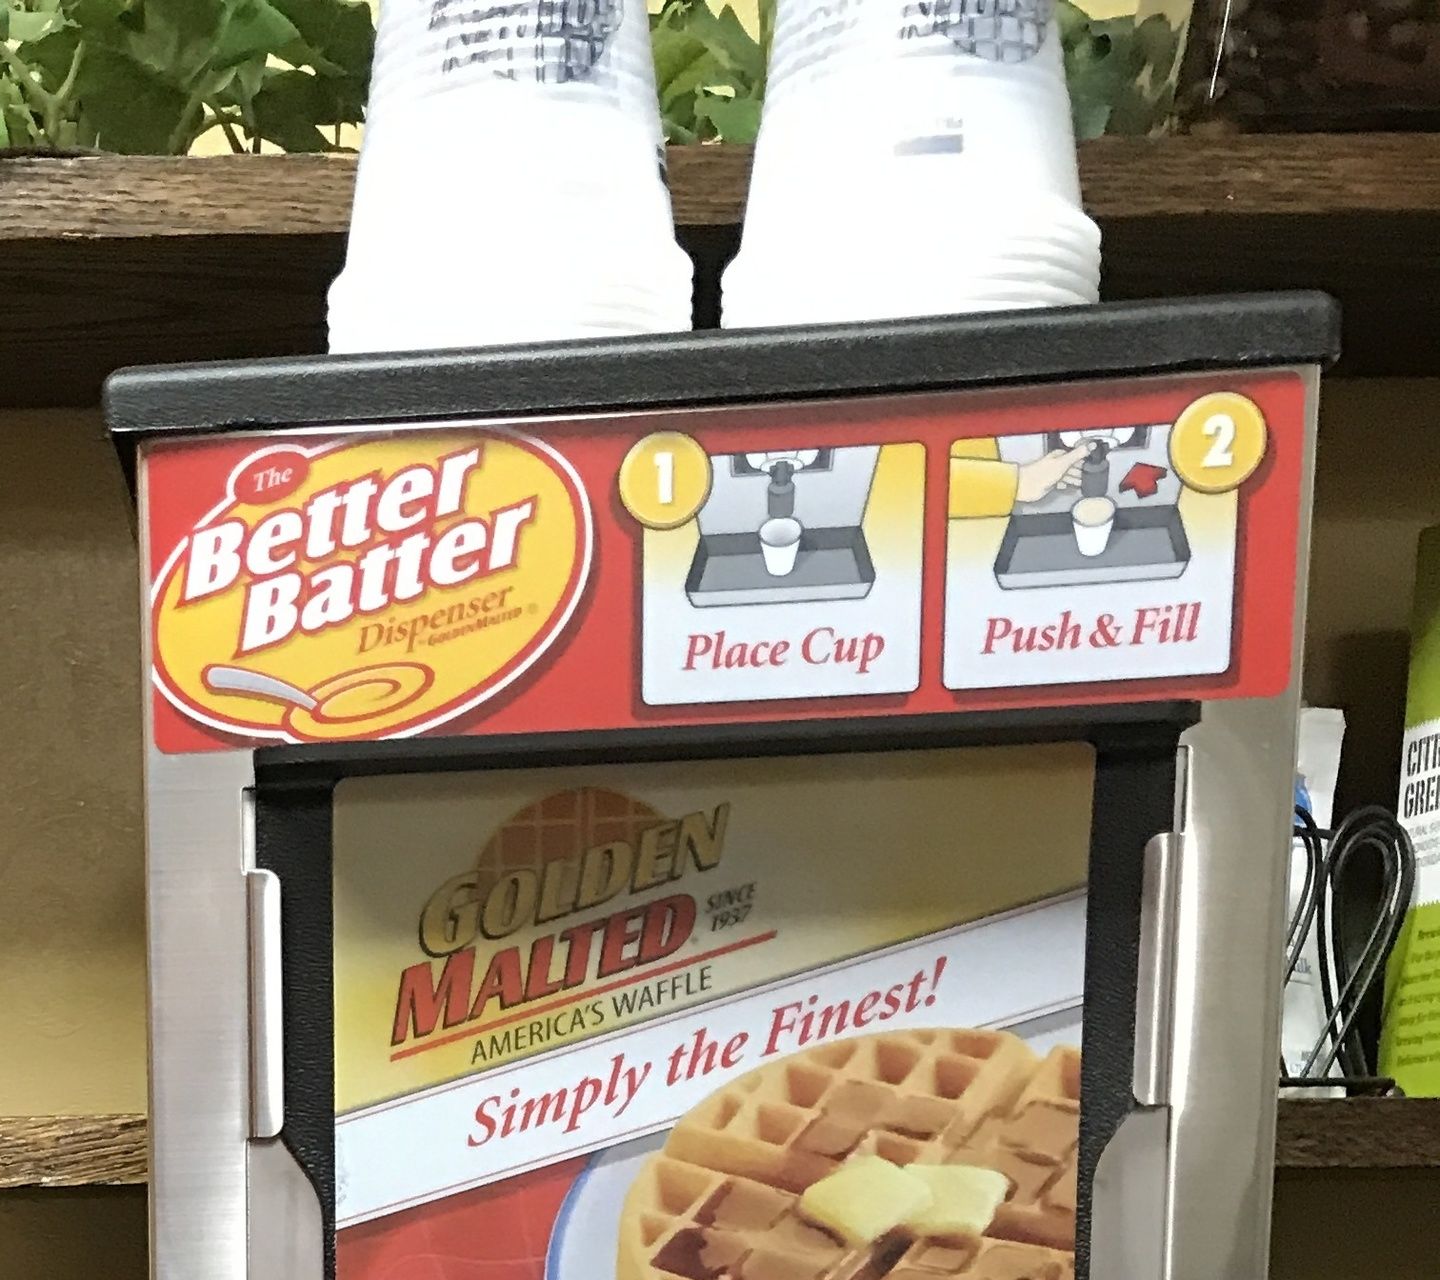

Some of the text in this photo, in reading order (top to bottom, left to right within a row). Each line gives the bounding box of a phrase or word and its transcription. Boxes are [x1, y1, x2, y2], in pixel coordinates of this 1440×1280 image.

[1201, 415, 1236, 470] 2
[253, 465, 294, 493] The
[654, 452, 674, 504] 1
[182, 446, 481, 602] Better
[239, 501, 534, 652] Batter
[357, 586, 515, 654] Dispenser
[682, 626, 886, 675] Place Cup
[980, 601, 1202, 656] Push & Fill
[419, 801, 730, 958] GOLDEN
[711, 903, 753, 933] 1937
[390, 881, 756, 1047] MALTED SINCE
[470, 965, 713, 1065] AMERICA'S WAFFLE
[467, 956, 948, 1148] Simply the Finest!
